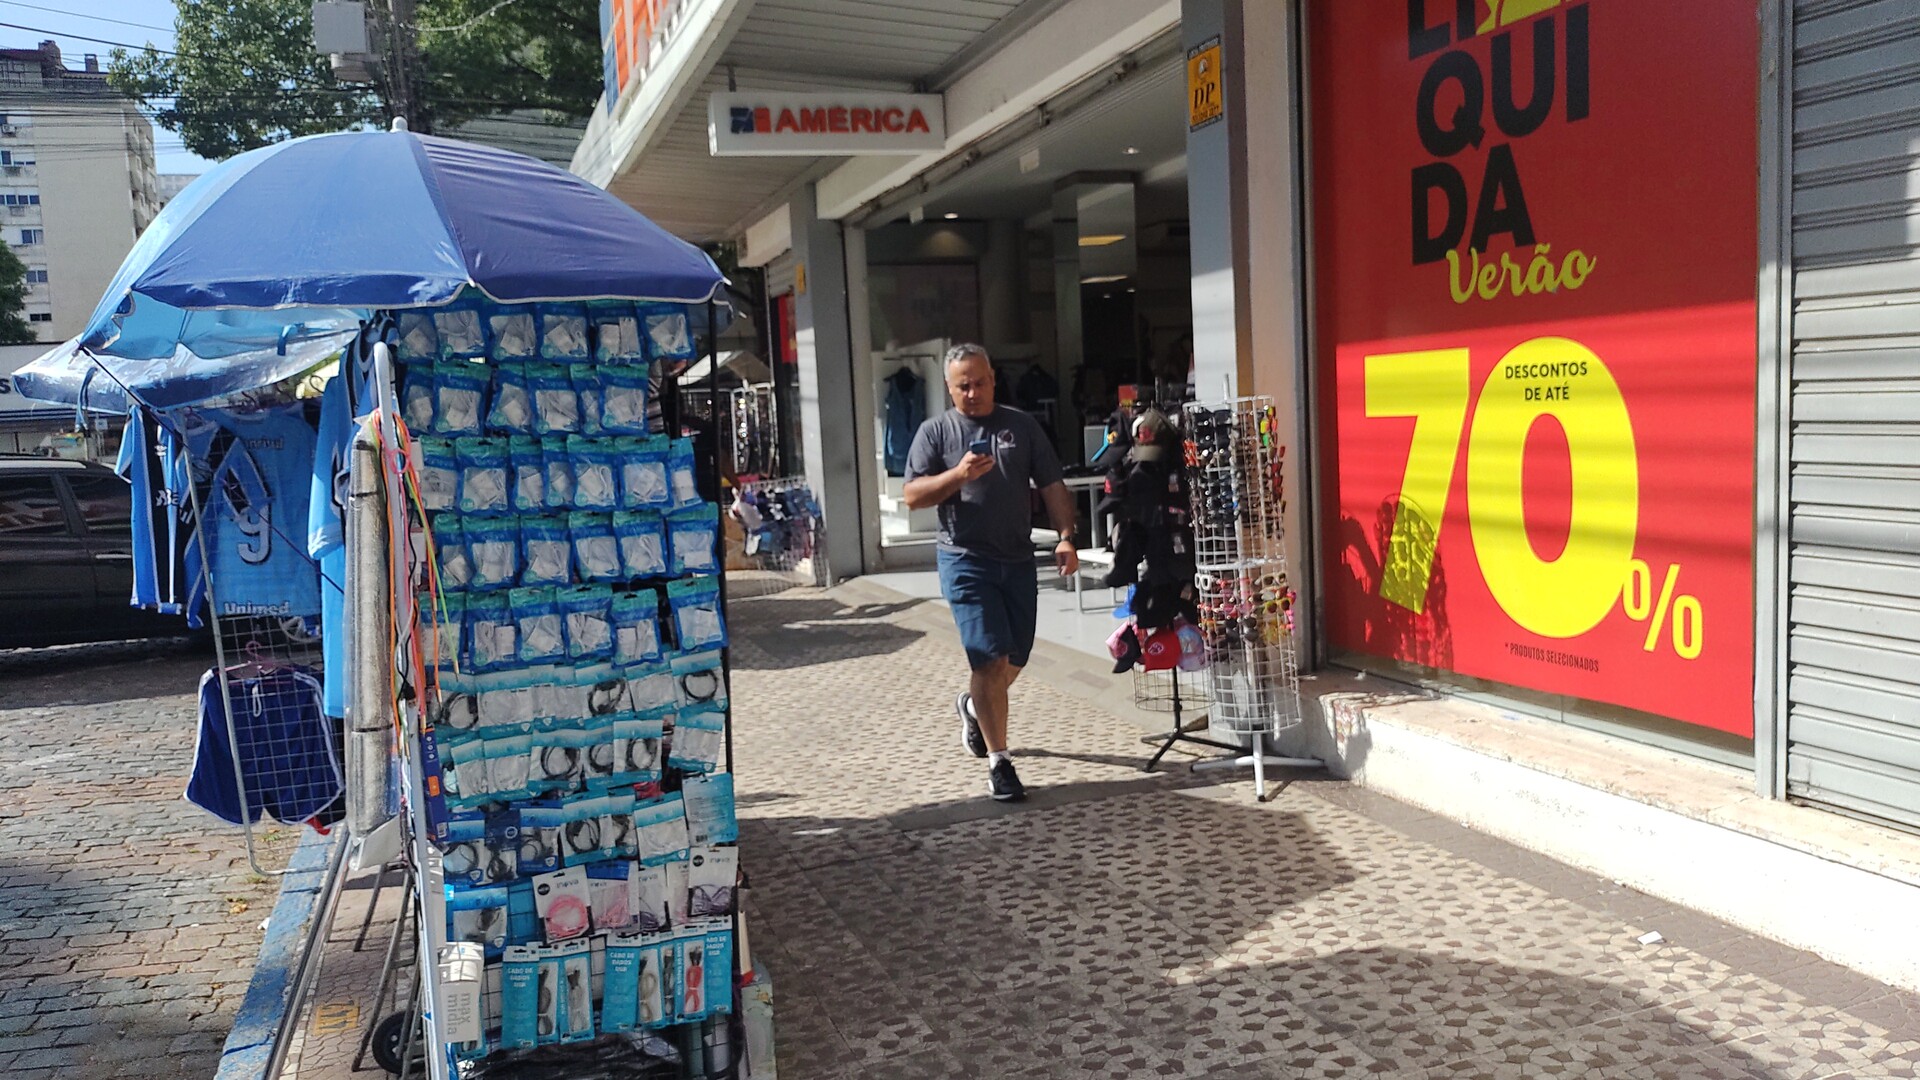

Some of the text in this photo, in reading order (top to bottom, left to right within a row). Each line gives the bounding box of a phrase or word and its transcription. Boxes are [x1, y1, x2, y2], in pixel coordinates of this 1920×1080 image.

[1416, 3, 1590, 158] QUI
[1411, 142, 1536, 266] DA
[1446, 243, 1597, 304] Verão
[1505, 361, 1588, 379] DESCONTOS
[1525, 381, 1569, 400] DE ATÉ
[224, 601, 292, 616] Unimed
[1510, 643, 1599, 673] PRODUTOS SELECIONADOS
[460, 992, 471, 1024] max
